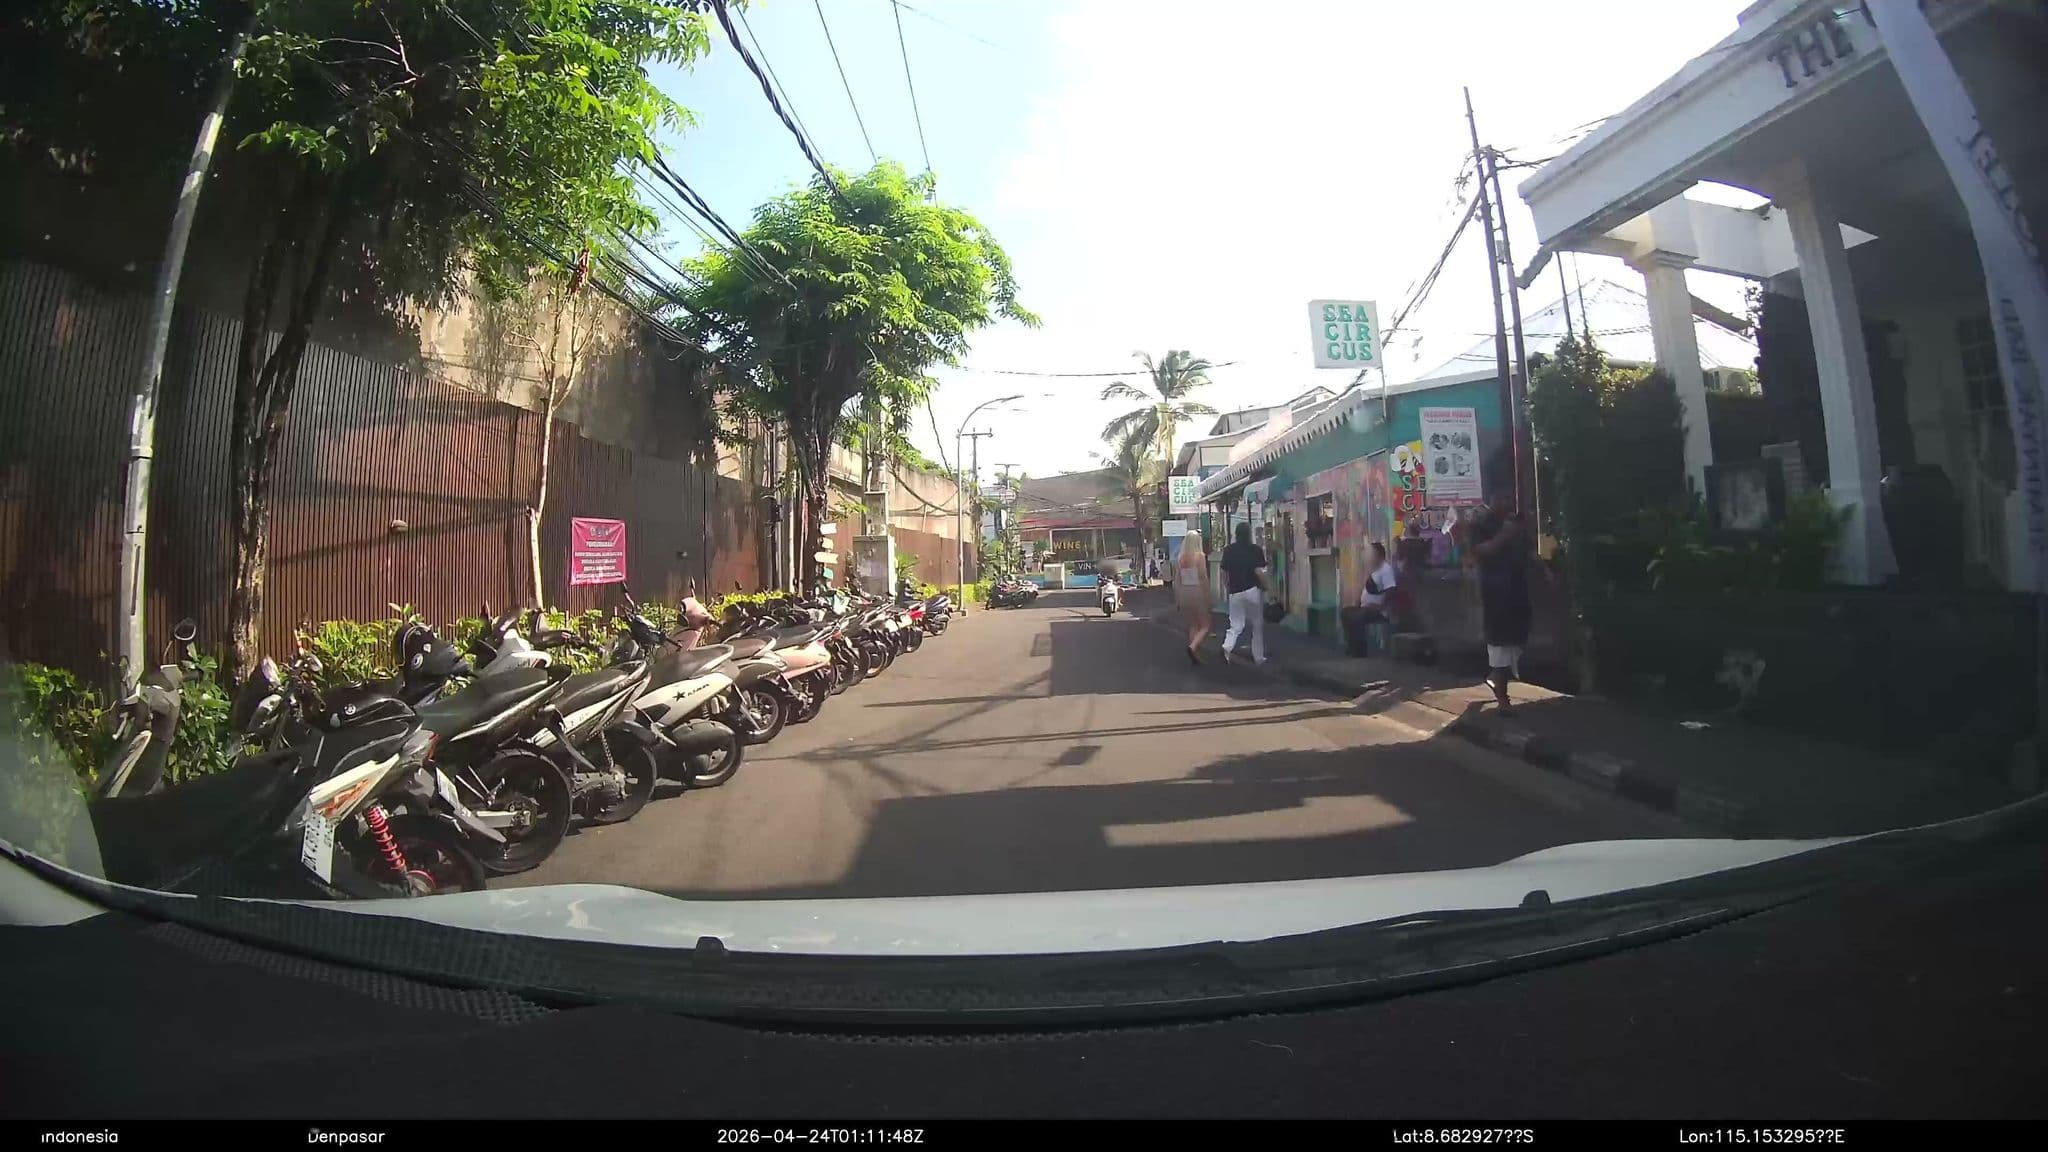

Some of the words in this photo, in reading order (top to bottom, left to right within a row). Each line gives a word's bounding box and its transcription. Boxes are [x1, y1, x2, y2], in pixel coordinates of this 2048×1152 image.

[1322, 304, 1369, 323] SEA
[1324, 323, 1372, 341] CIR
[1327, 342, 1373, 361] CUS
